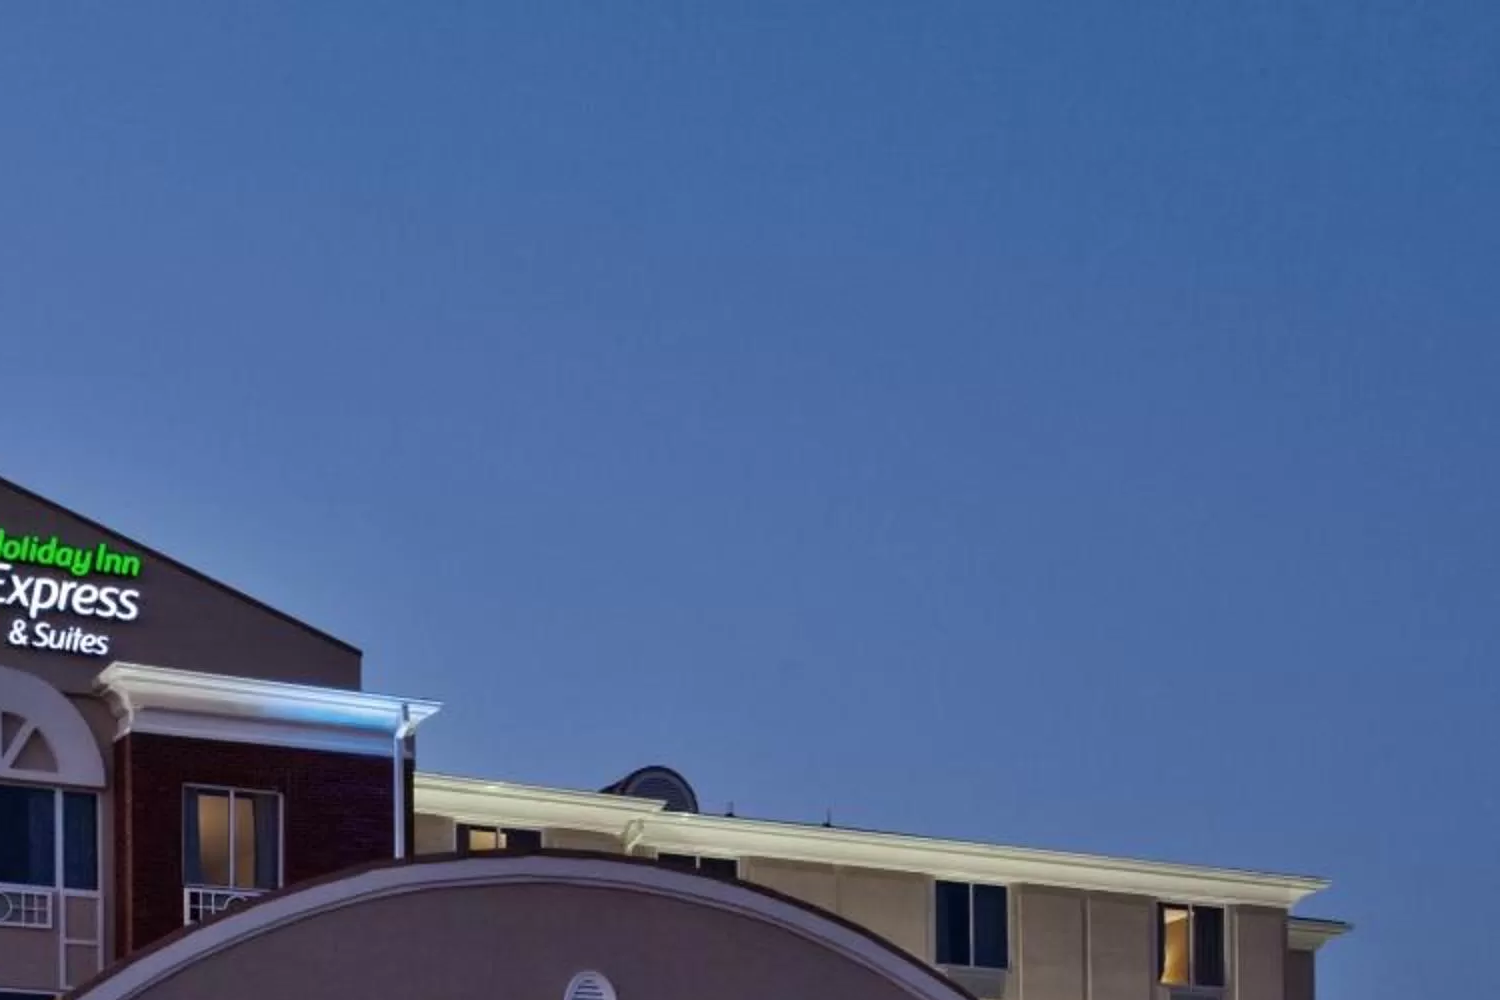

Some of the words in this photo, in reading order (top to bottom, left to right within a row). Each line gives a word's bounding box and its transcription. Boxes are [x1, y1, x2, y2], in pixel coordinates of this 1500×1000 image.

[96, 543, 141, 577] Inn
[8, 618, 29, 646] &
[32, 622, 110, 656] Suites
